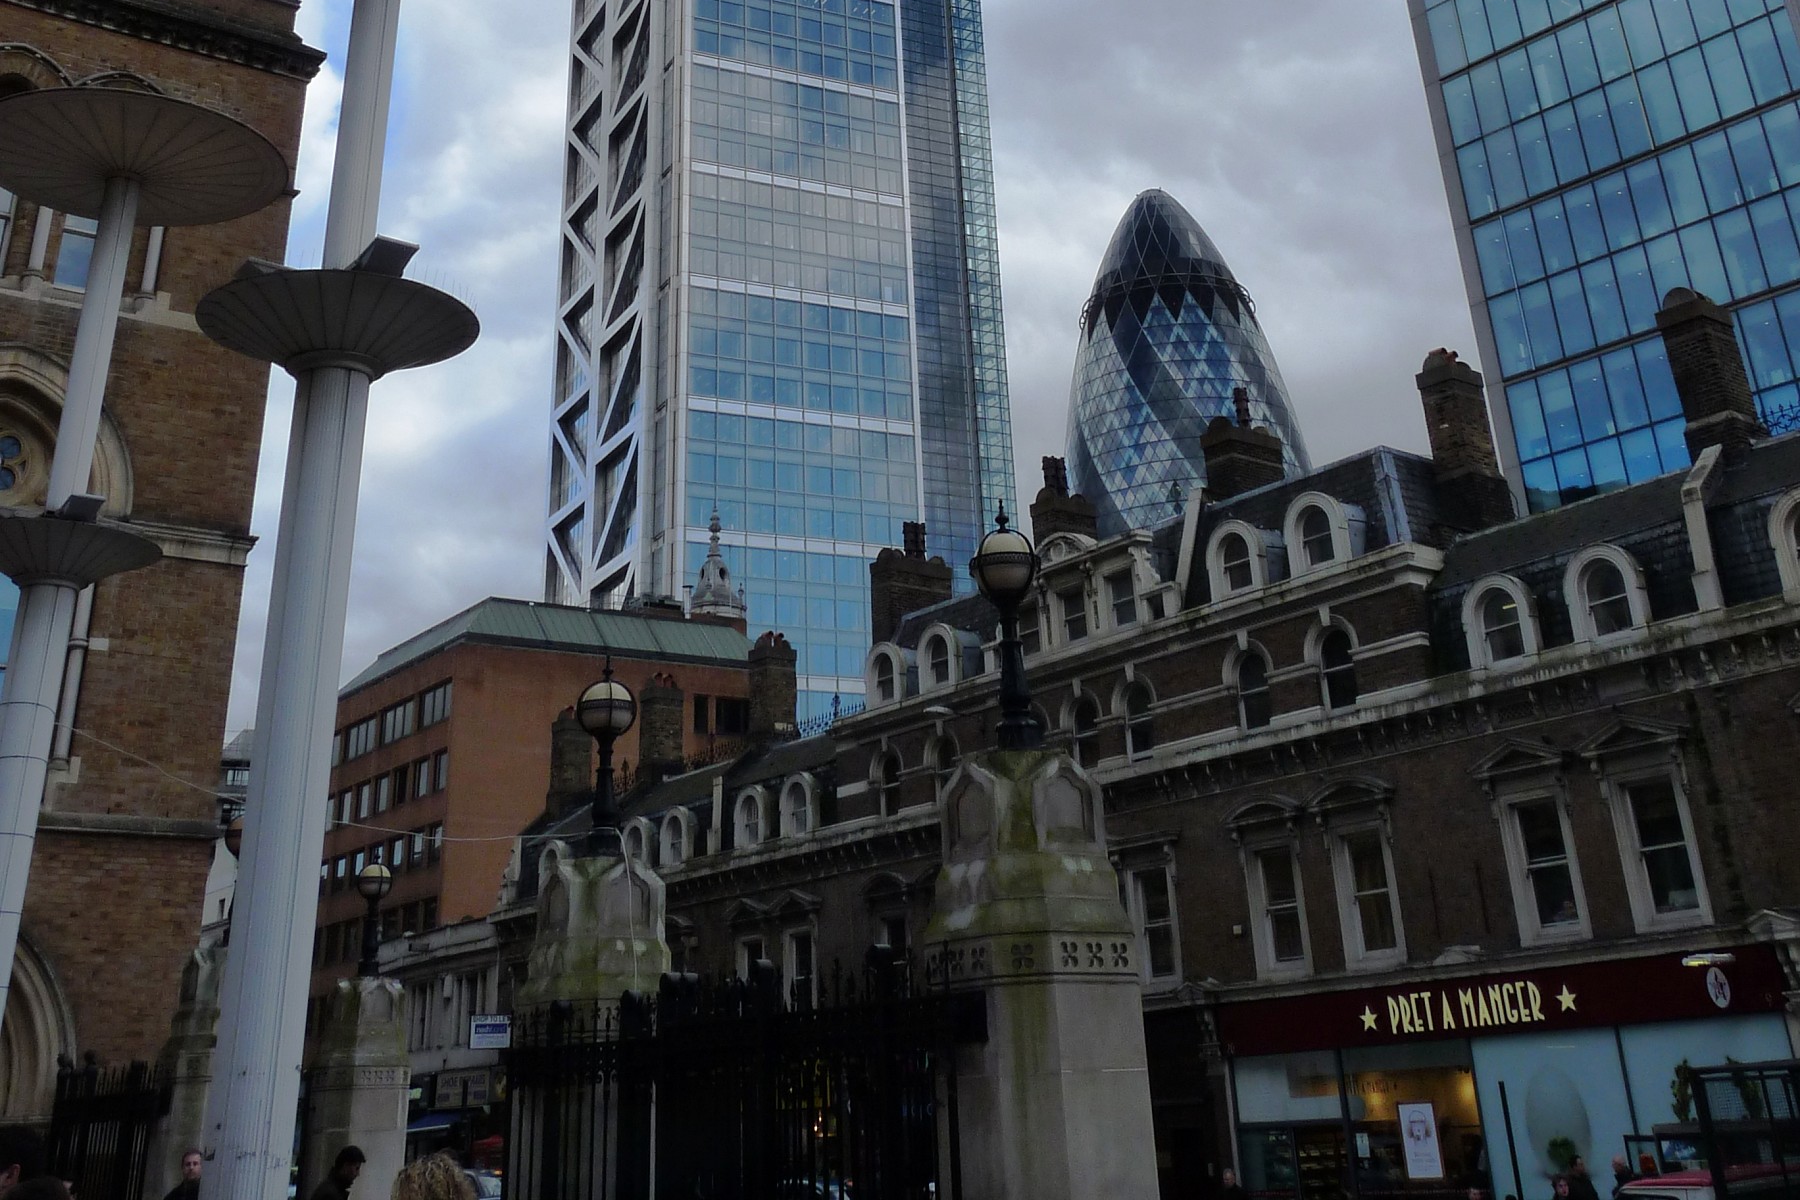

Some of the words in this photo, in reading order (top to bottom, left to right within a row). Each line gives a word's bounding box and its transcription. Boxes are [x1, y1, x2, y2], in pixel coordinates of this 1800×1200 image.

[1386, 991, 1435, 1035] PRET
[1441, 989, 1456, 1030] A
[1458, 980, 1545, 1028] MANGER
[440, 1076, 458, 1088] SHOE
